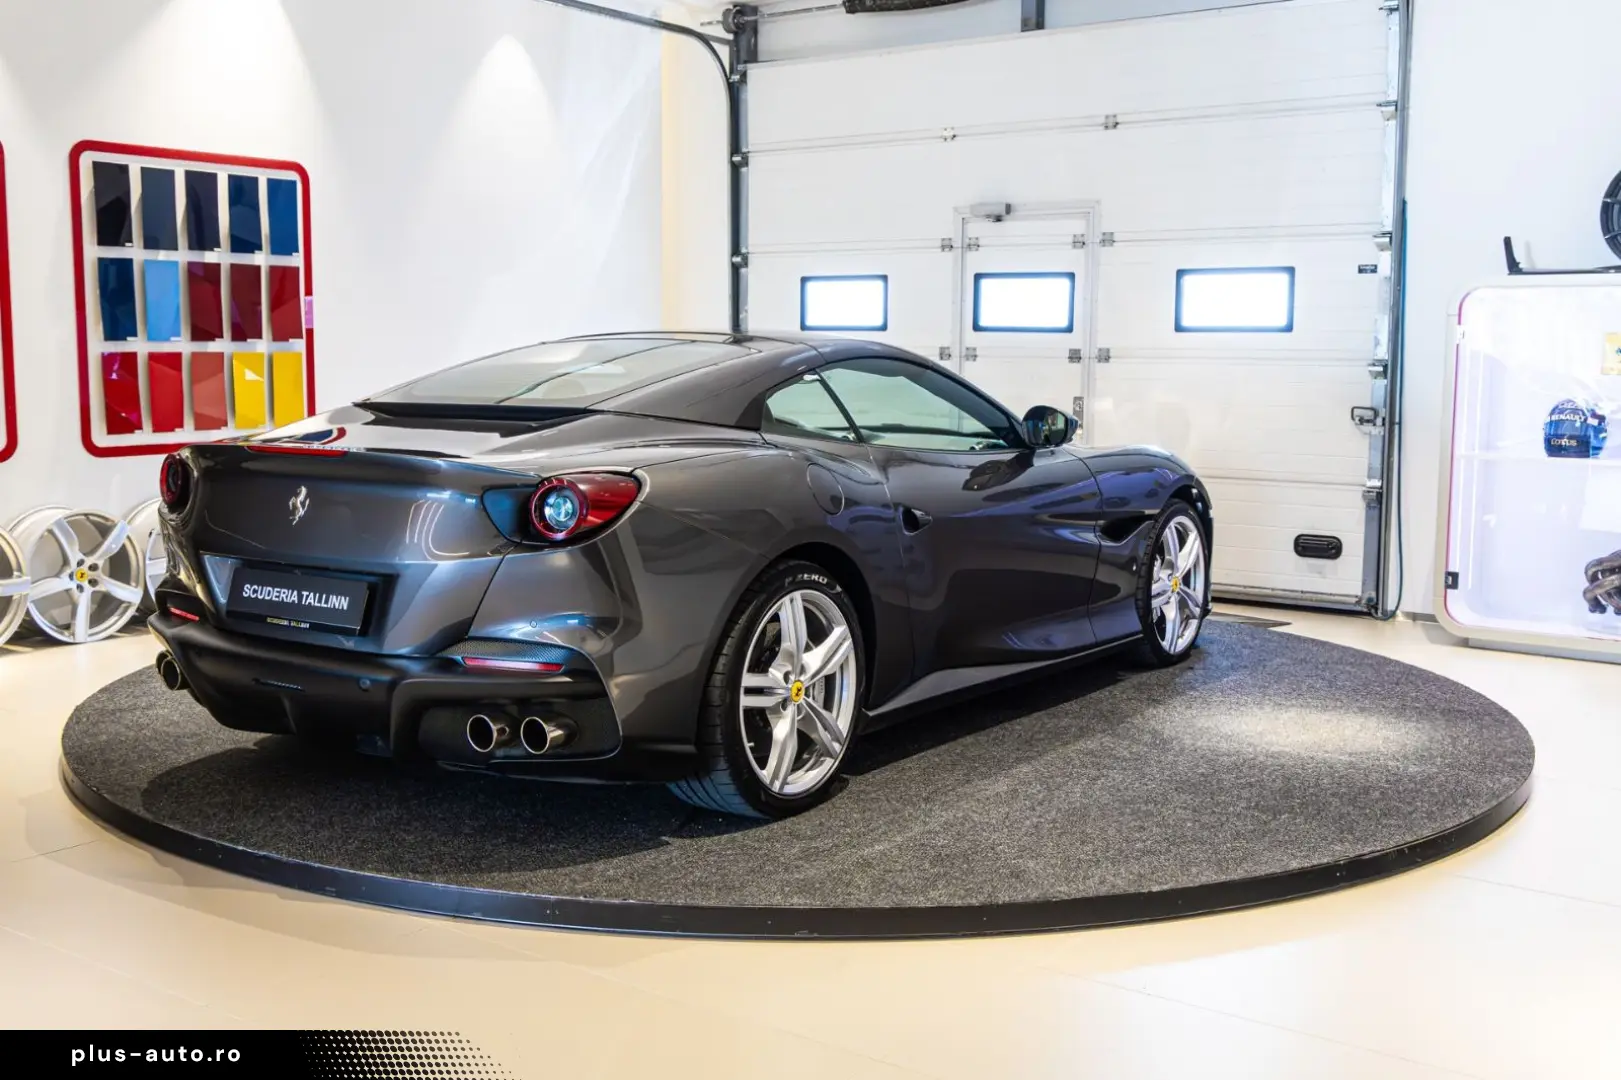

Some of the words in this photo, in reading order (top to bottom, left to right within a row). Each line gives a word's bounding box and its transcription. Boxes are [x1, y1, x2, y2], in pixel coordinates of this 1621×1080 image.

[1550, 438, 1578, 447] LOTUS
[796, 573, 828, 584] ZERO
[242, 583, 298, 604] SCUDERIA
[301, 590, 349, 610] TALLINN
